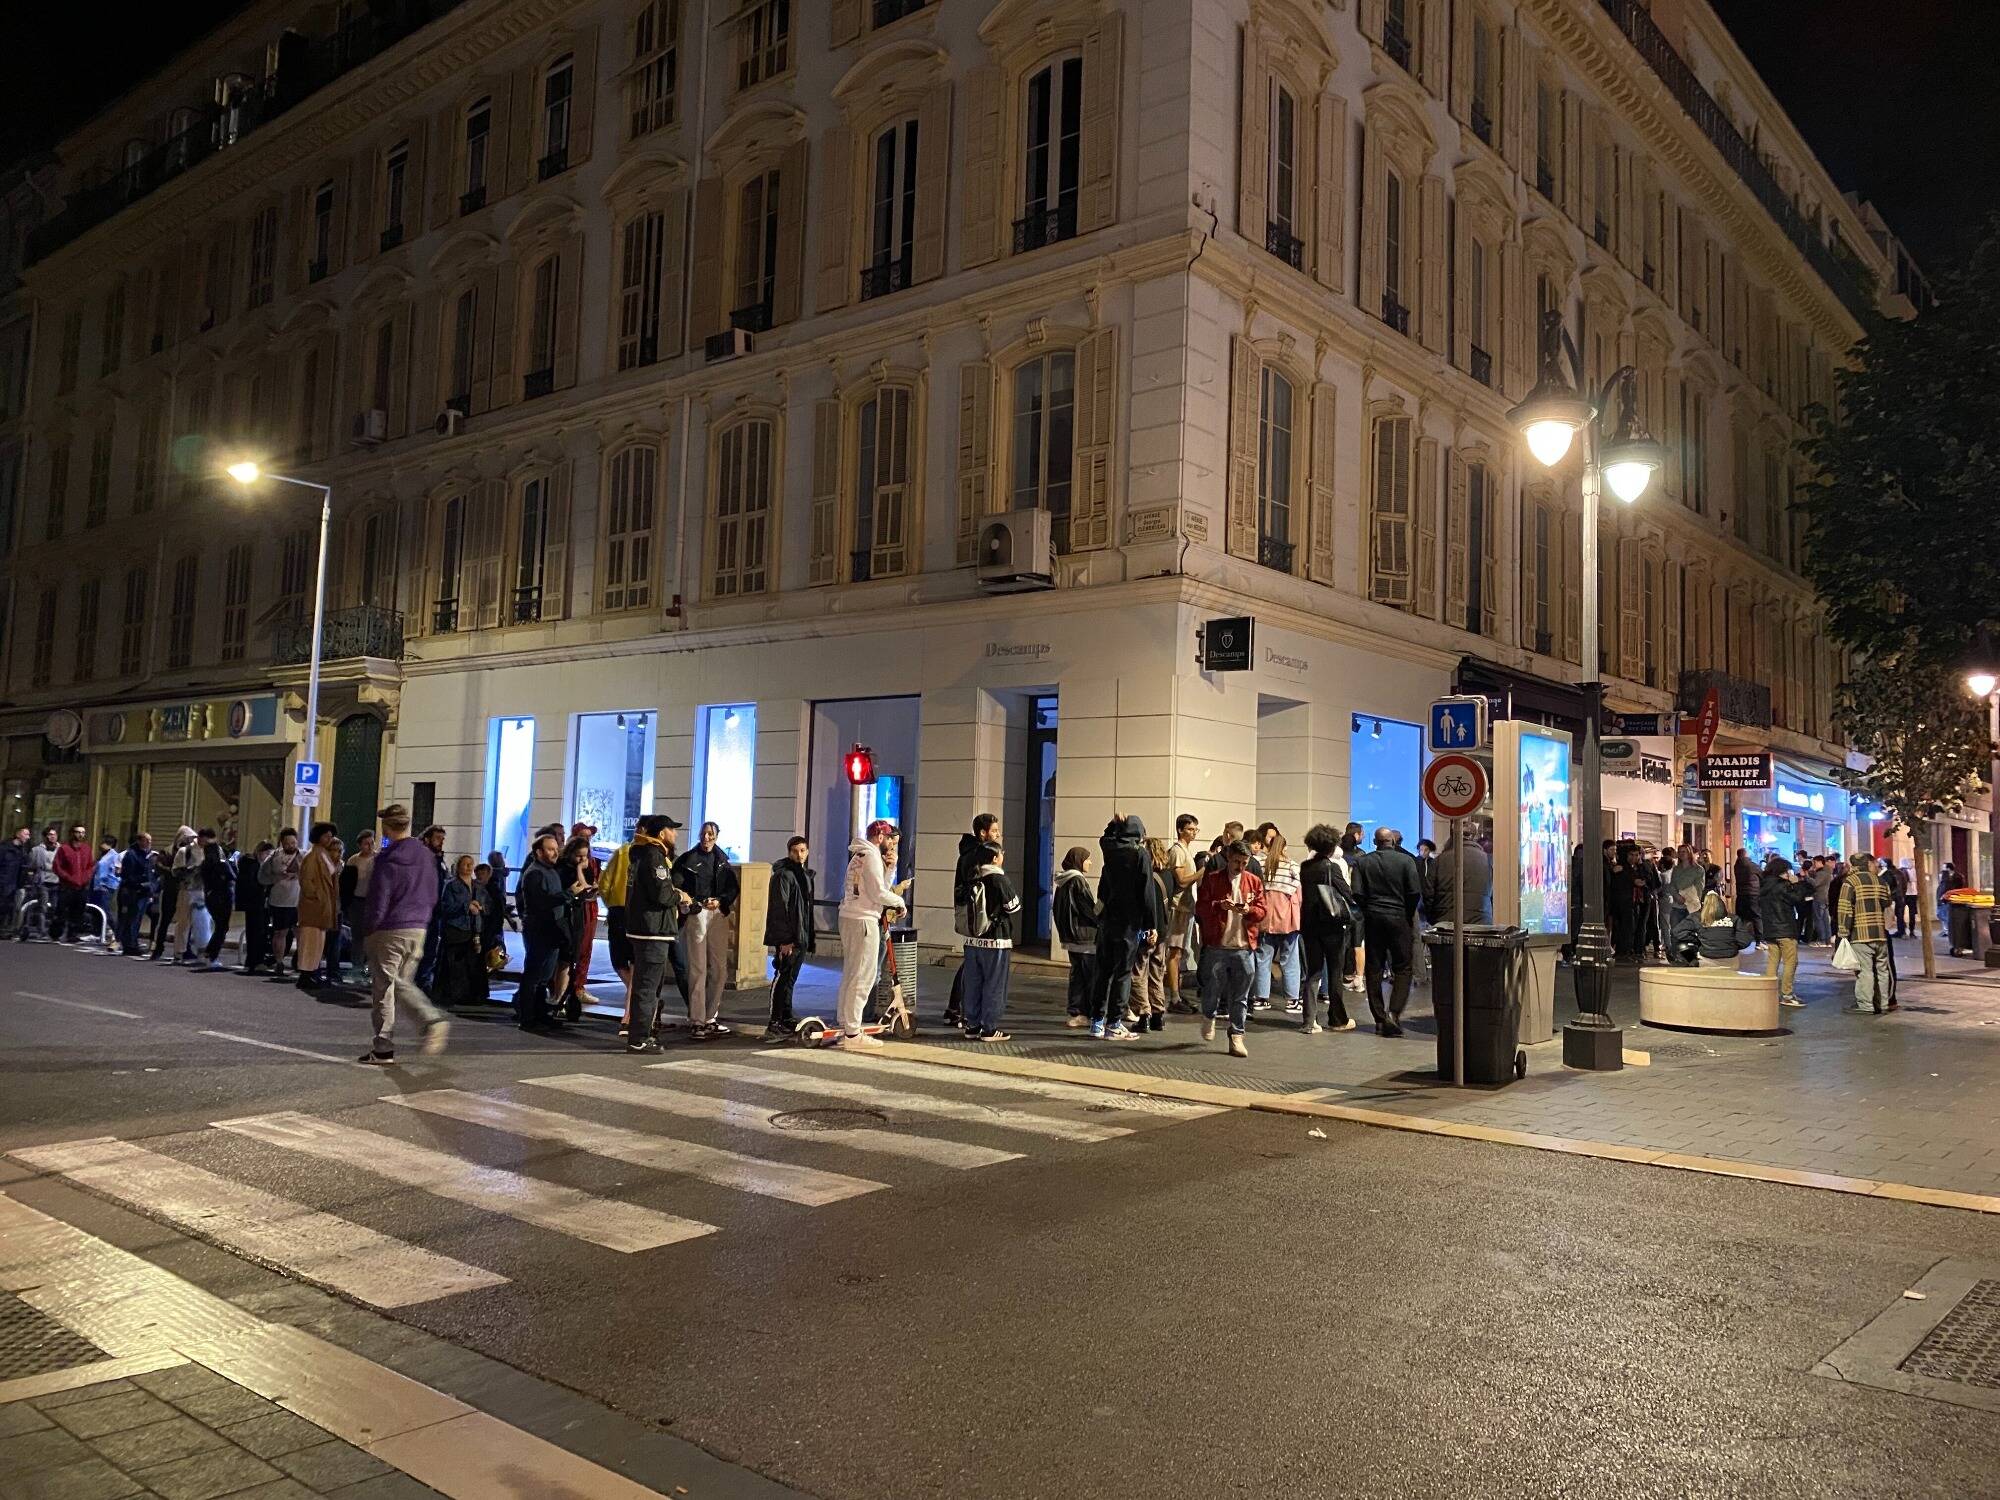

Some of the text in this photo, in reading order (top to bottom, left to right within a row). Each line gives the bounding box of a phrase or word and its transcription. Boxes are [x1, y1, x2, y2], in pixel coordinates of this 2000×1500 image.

[985, 642, 1051, 658] Descamps
[1209, 650, 1245, 659] Descamps
[1265, 647, 1308, 673] Descamps
[1701, 701, 1715, 744] TABAC
[1708, 757, 1760, 766] PARADIS
[302, 766, 314, 781] P
